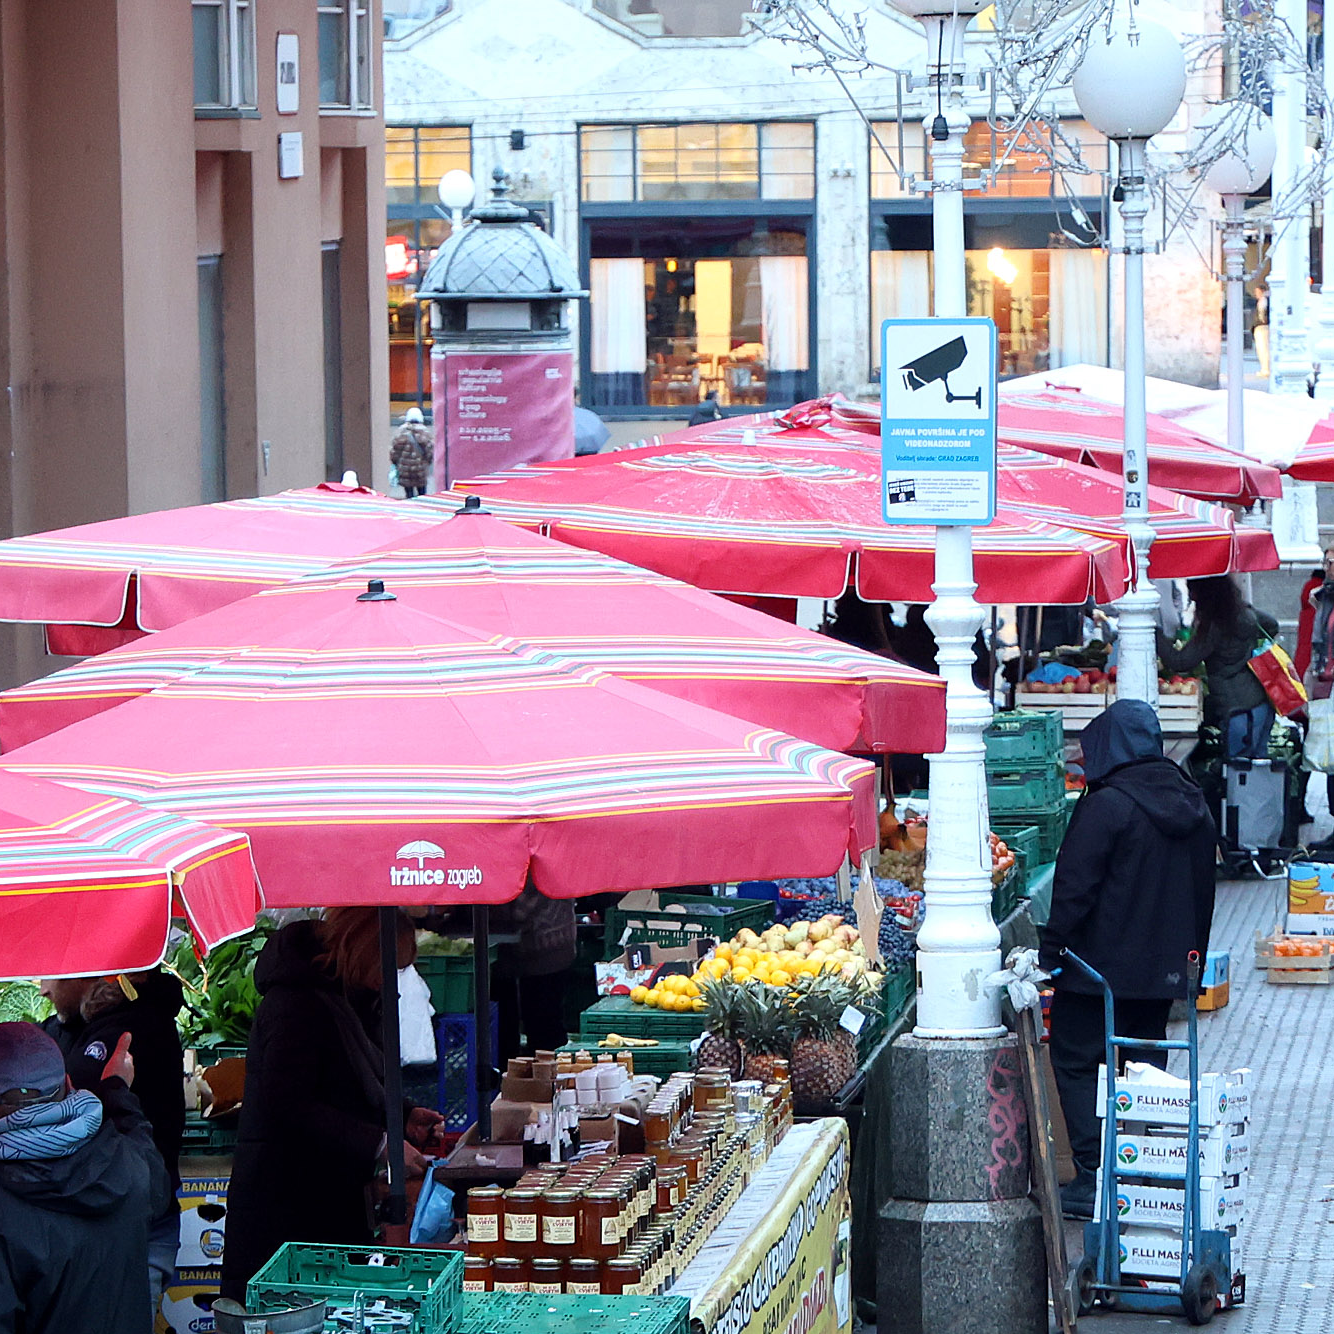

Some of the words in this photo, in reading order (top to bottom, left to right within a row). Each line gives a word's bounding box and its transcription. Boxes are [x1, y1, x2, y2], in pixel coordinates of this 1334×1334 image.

[891, 428, 916, 436] JAVNA
[917, 427, 956, 437] POVRŠINA
[958, 428, 967, 437] JE
[969, 428, 985, 437] POD
[904, 439, 971, 448] VIDEONADZOROM
[390, 866, 445, 886] tržnice
[447, 865, 483, 890] zagreb
[1137, 1095, 1160, 1105] F.LLI
[1162, 1097, 1190, 1107] MASS
[1143, 1147, 1166, 1157] F.LLI
[1134, 1198, 1158, 1209] F.LLI
[1132, 1247, 1156, 1257] F.LLI
[179, 1271, 222, 1281] BANAN
